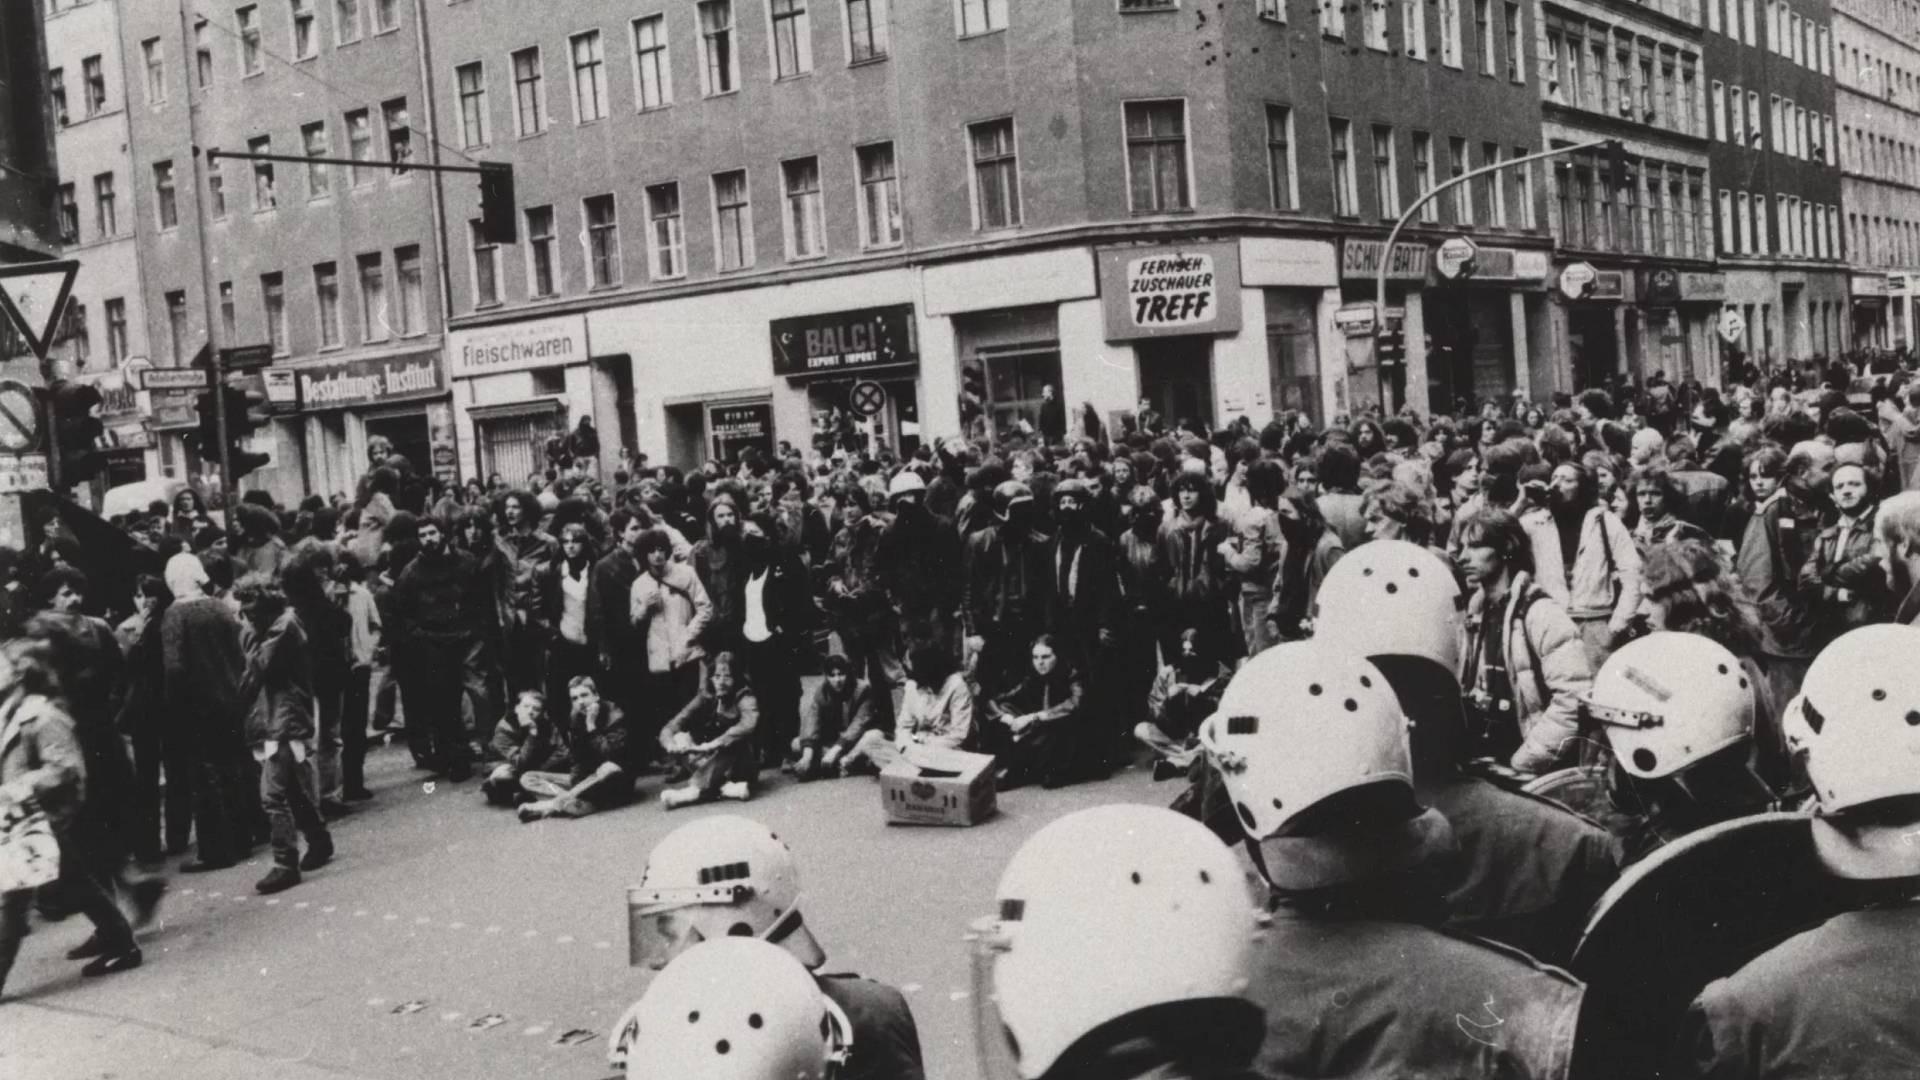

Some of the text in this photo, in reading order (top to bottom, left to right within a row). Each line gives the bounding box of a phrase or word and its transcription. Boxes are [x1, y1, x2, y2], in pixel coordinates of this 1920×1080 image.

[1131, 273, 1213, 293] ZUSCHAUER
[1136, 291, 1211, 324] TREFF
[808, 351, 877, 368] EXPORT IMPORT
